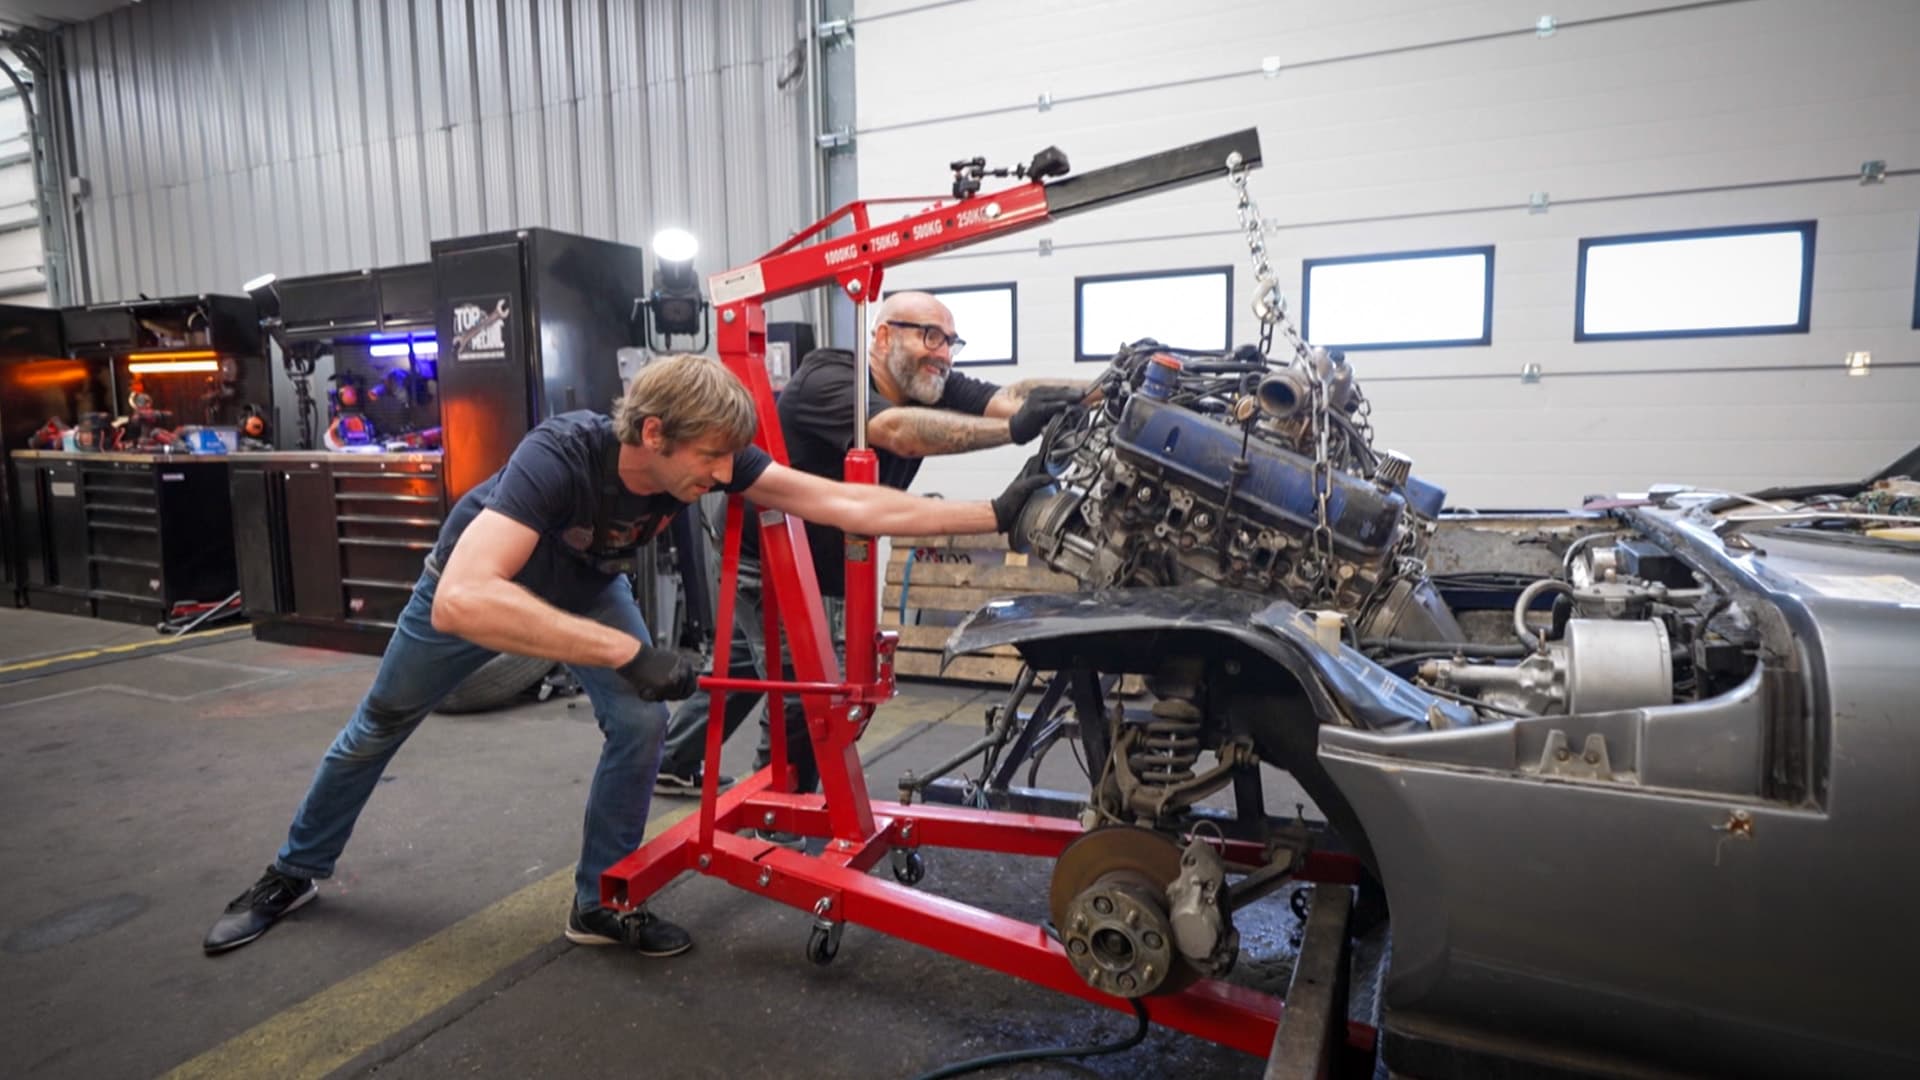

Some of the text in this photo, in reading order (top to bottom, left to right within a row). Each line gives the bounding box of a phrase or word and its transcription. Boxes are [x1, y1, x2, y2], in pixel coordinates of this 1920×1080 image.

[824, 243, 858, 266] 1000KG
[870, 231, 900, 253] 750KG
[913, 219, 943, 240] 500KG
[454, 305, 481, 333] TOP
